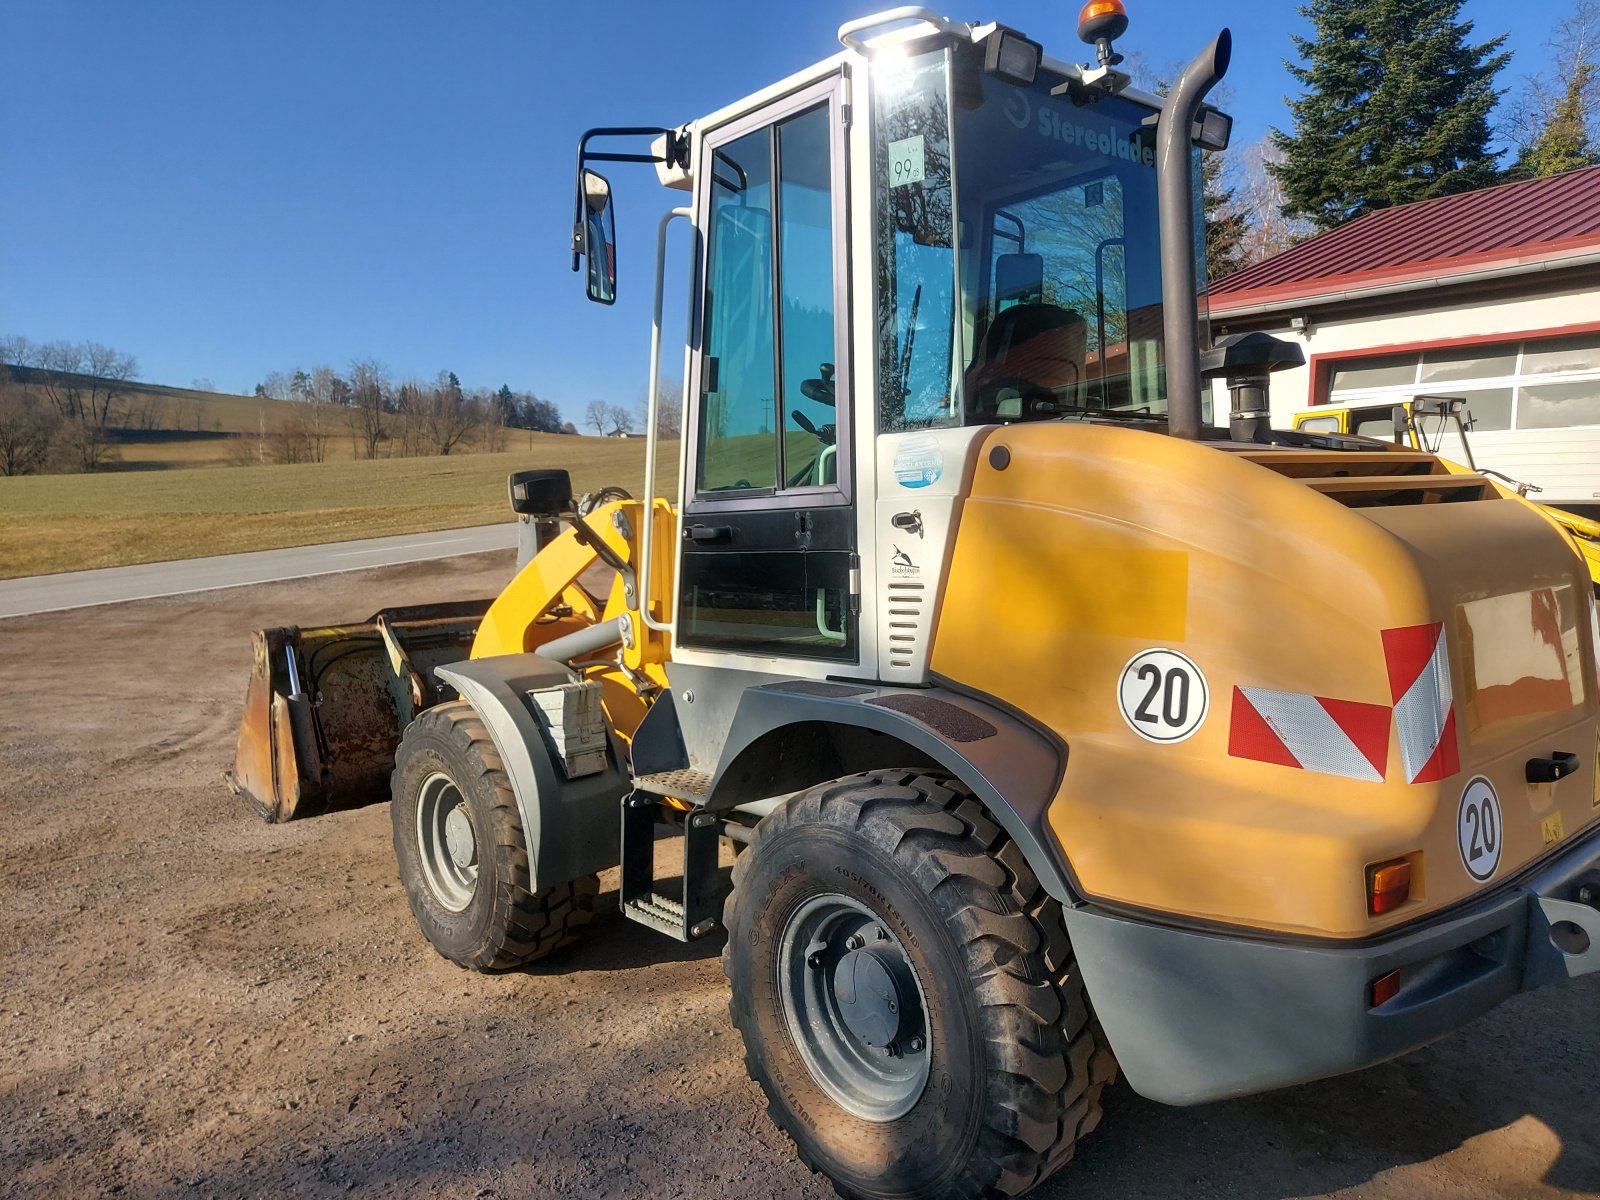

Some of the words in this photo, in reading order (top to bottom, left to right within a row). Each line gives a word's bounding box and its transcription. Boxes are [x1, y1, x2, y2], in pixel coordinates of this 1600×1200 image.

[894, 158, 912, 181] 99
[1134, 663, 1190, 728] 20
[1465, 800, 1496, 862] 20
[787, 1093, 818, 1131] MULTI
